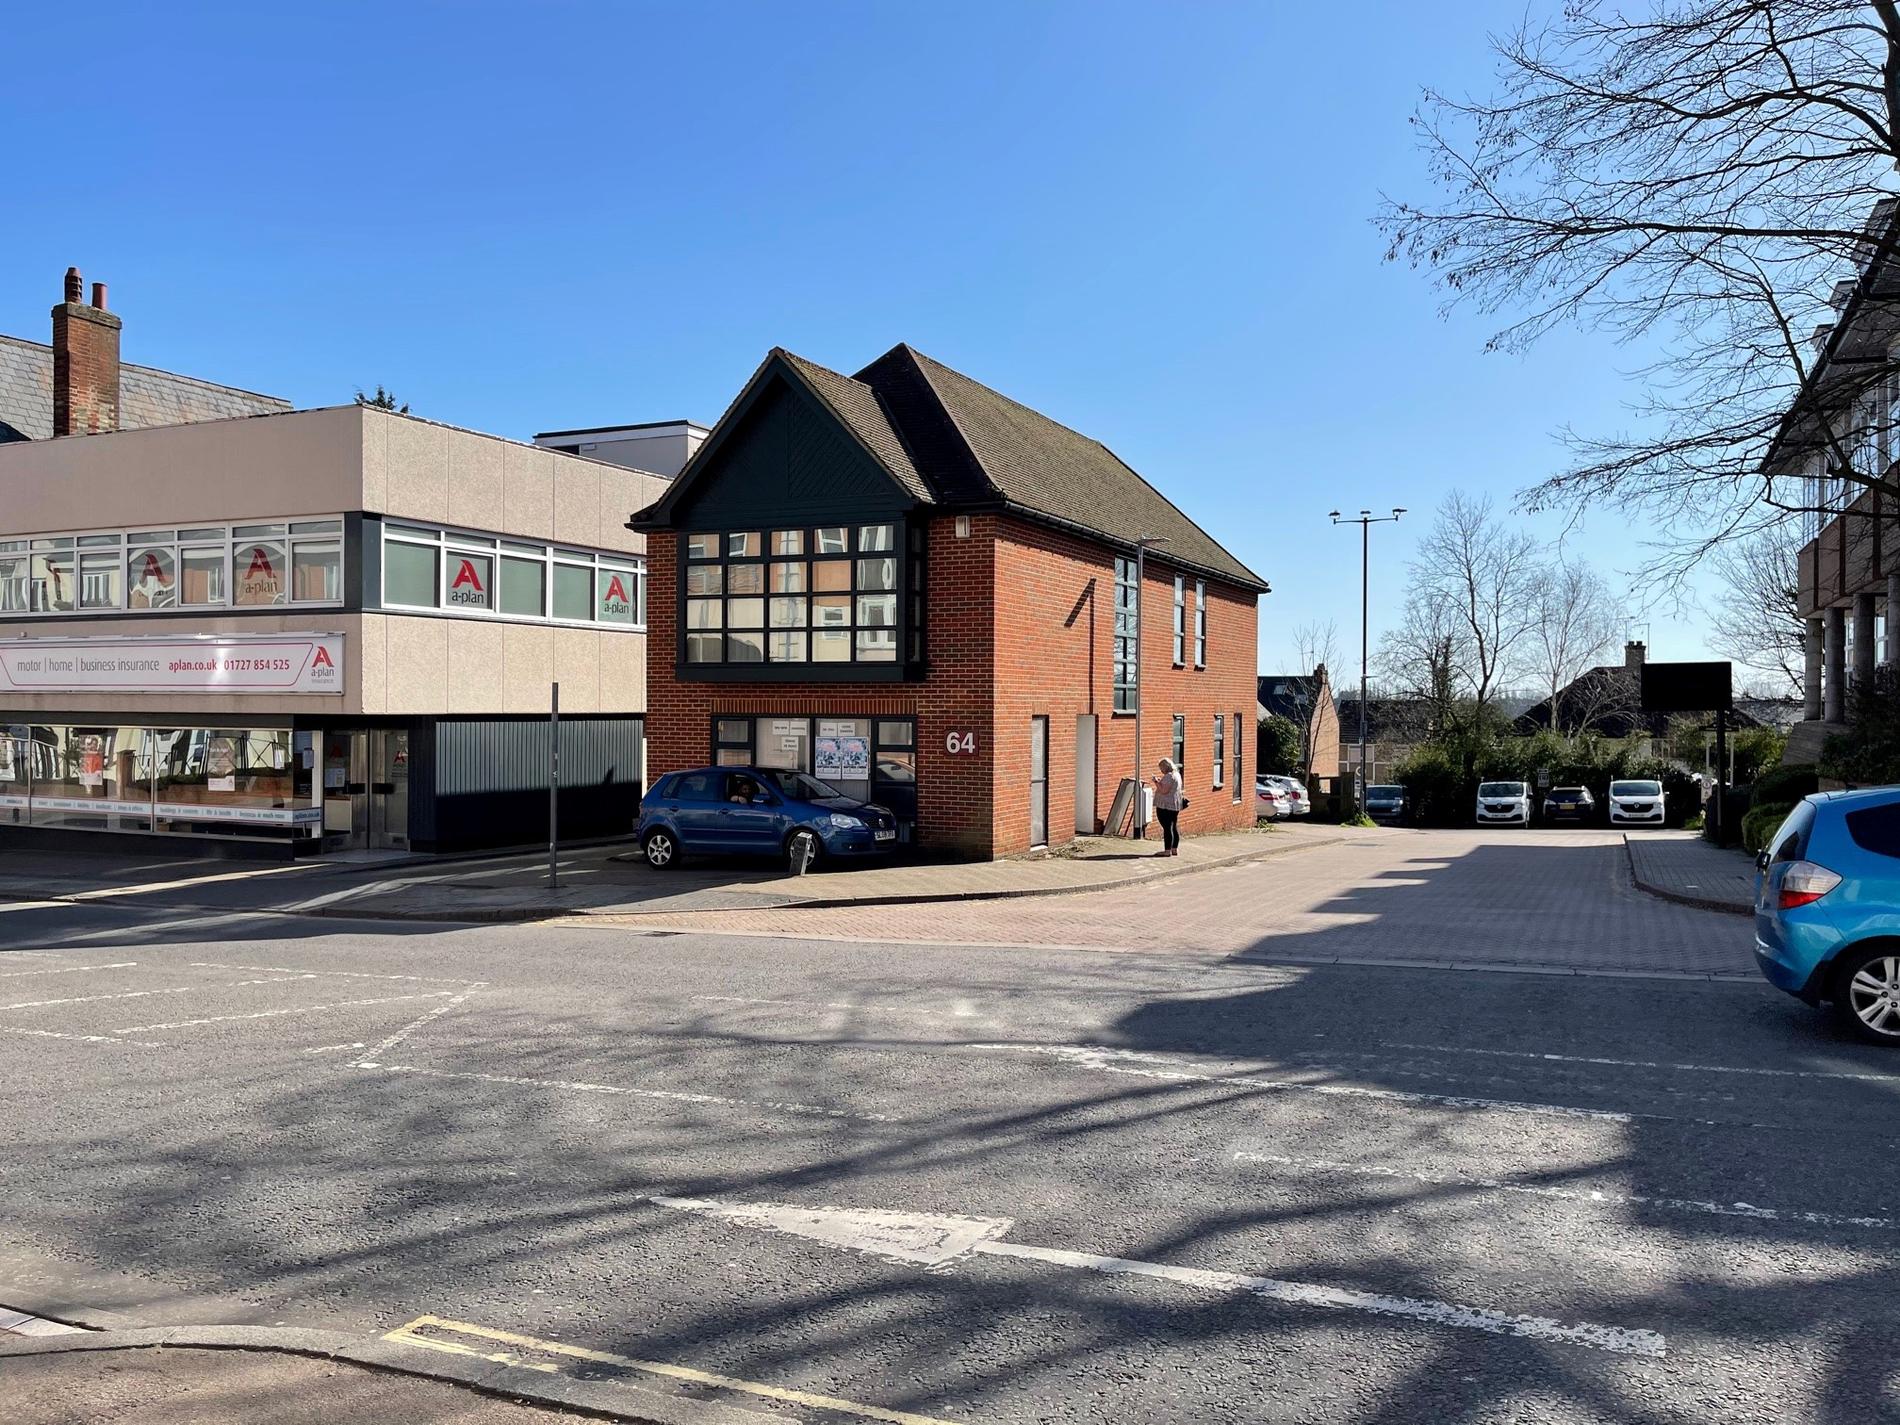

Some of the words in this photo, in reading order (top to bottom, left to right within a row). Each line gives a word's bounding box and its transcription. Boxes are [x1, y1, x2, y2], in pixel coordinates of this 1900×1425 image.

[451, 590, 484, 605] a-plan
[604, 602, 630, 614] a-plan
[17, 660, 41, 672] motor
[49, 658, 73, 672] home
[80, 658, 116, 672] business
[117, 658, 160, 672] insurance
[168, 659, 218, 673] aplan.co.uk
[224, 660, 251, 671] 01727
[254, 660, 271, 671] 854
[273, 660, 290, 671] 525
[311, 667, 335, 677] a-plan
[946, 731, 976, 754] 64
